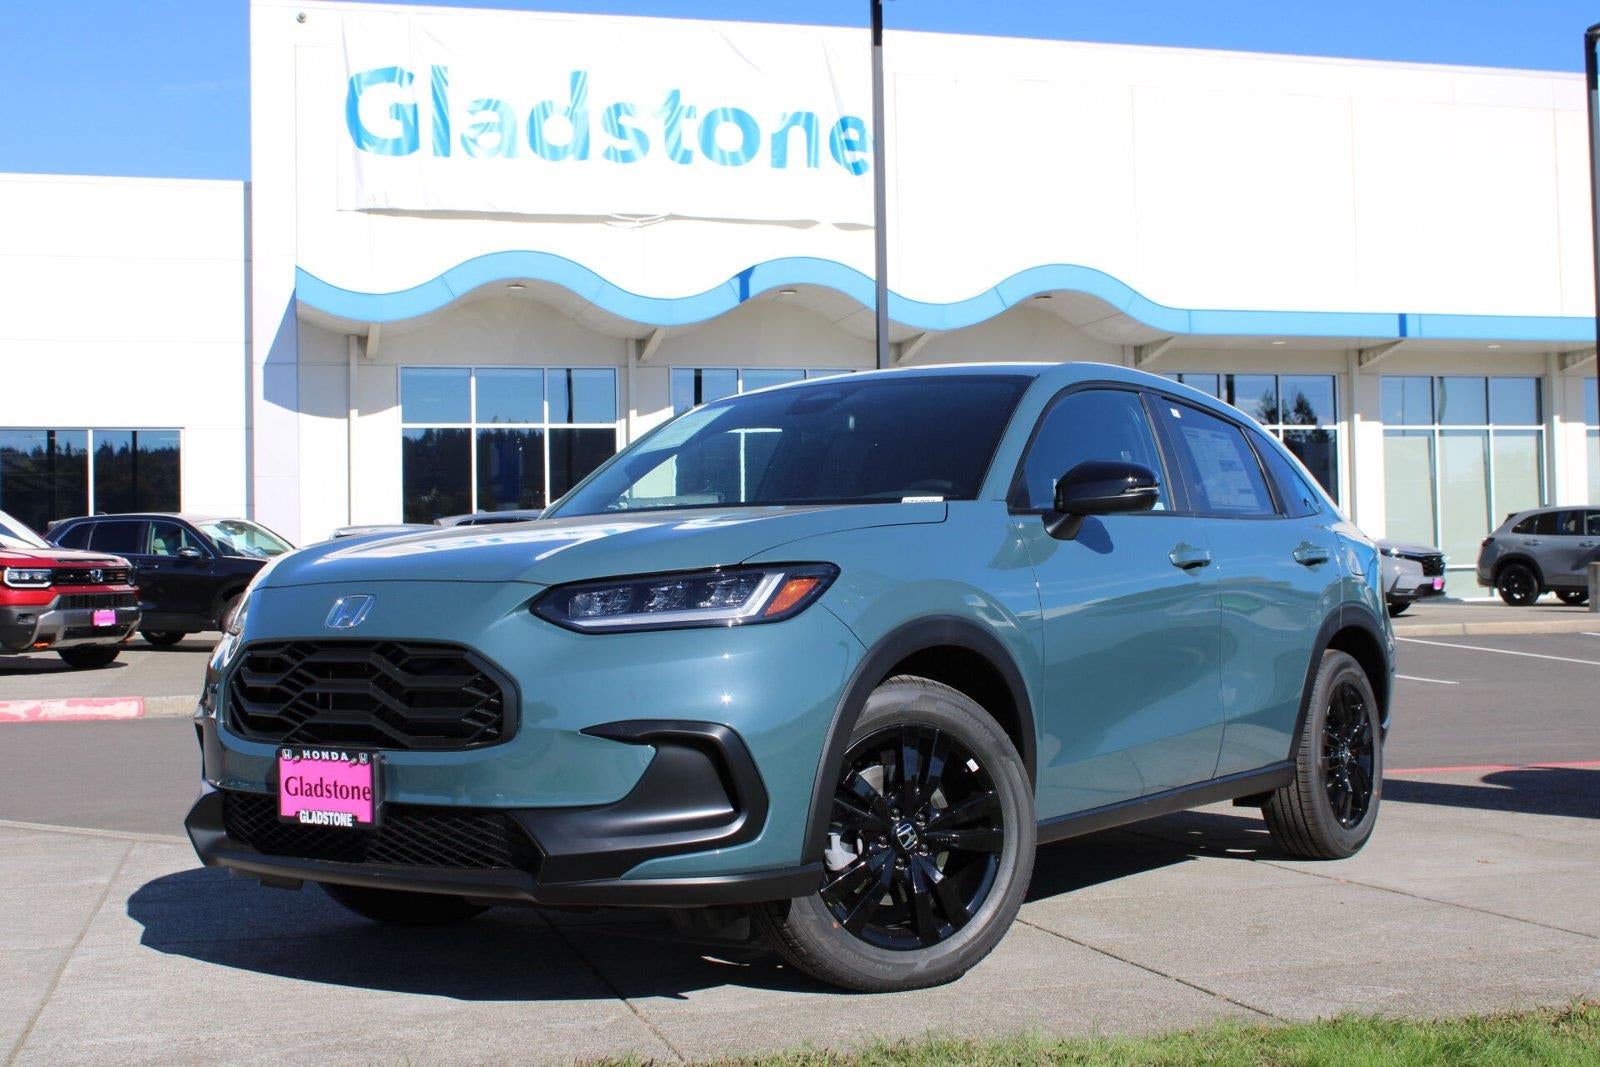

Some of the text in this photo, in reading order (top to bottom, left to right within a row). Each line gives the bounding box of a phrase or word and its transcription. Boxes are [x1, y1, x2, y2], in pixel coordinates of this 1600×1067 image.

[346, 65, 870, 176] Gladstone
[302, 750, 349, 761] HONDA
[284, 775, 372, 802] Gladstone
[299, 809, 354, 828] GLADSTONE
